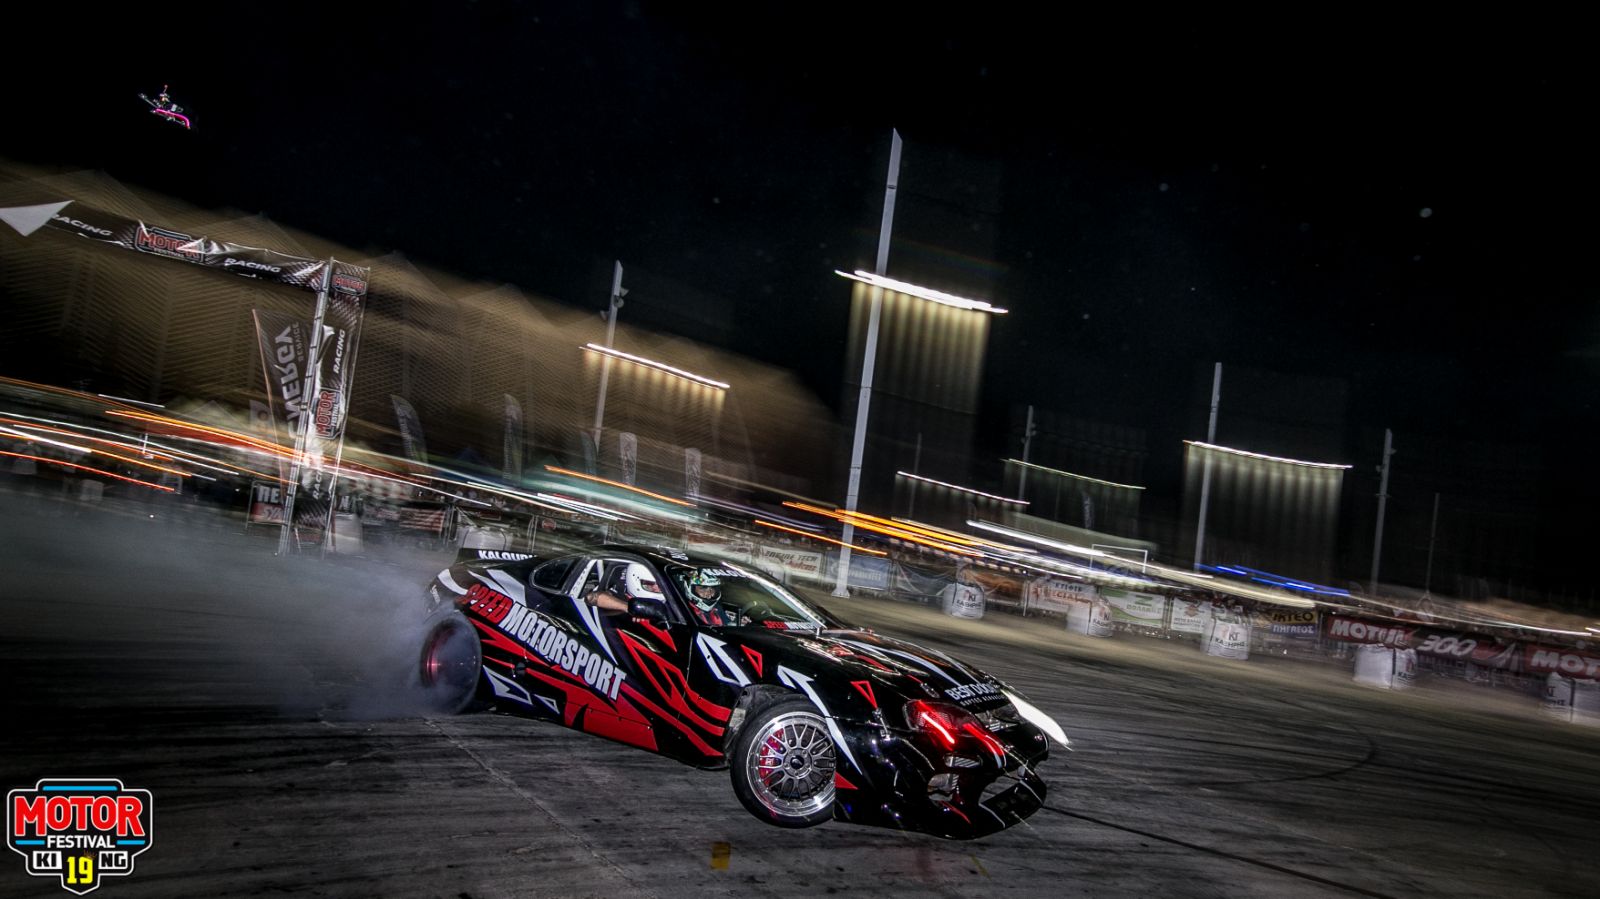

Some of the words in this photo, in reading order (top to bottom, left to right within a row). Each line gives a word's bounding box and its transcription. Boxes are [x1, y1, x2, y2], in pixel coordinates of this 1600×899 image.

[224, 257, 281, 273] RACING
[332, 329, 346, 374] RACING
[316, 391, 336, 437] MOTOR
[1330, 619, 1408, 646] MOTUL
[944, 684, 976, 700] BEST
